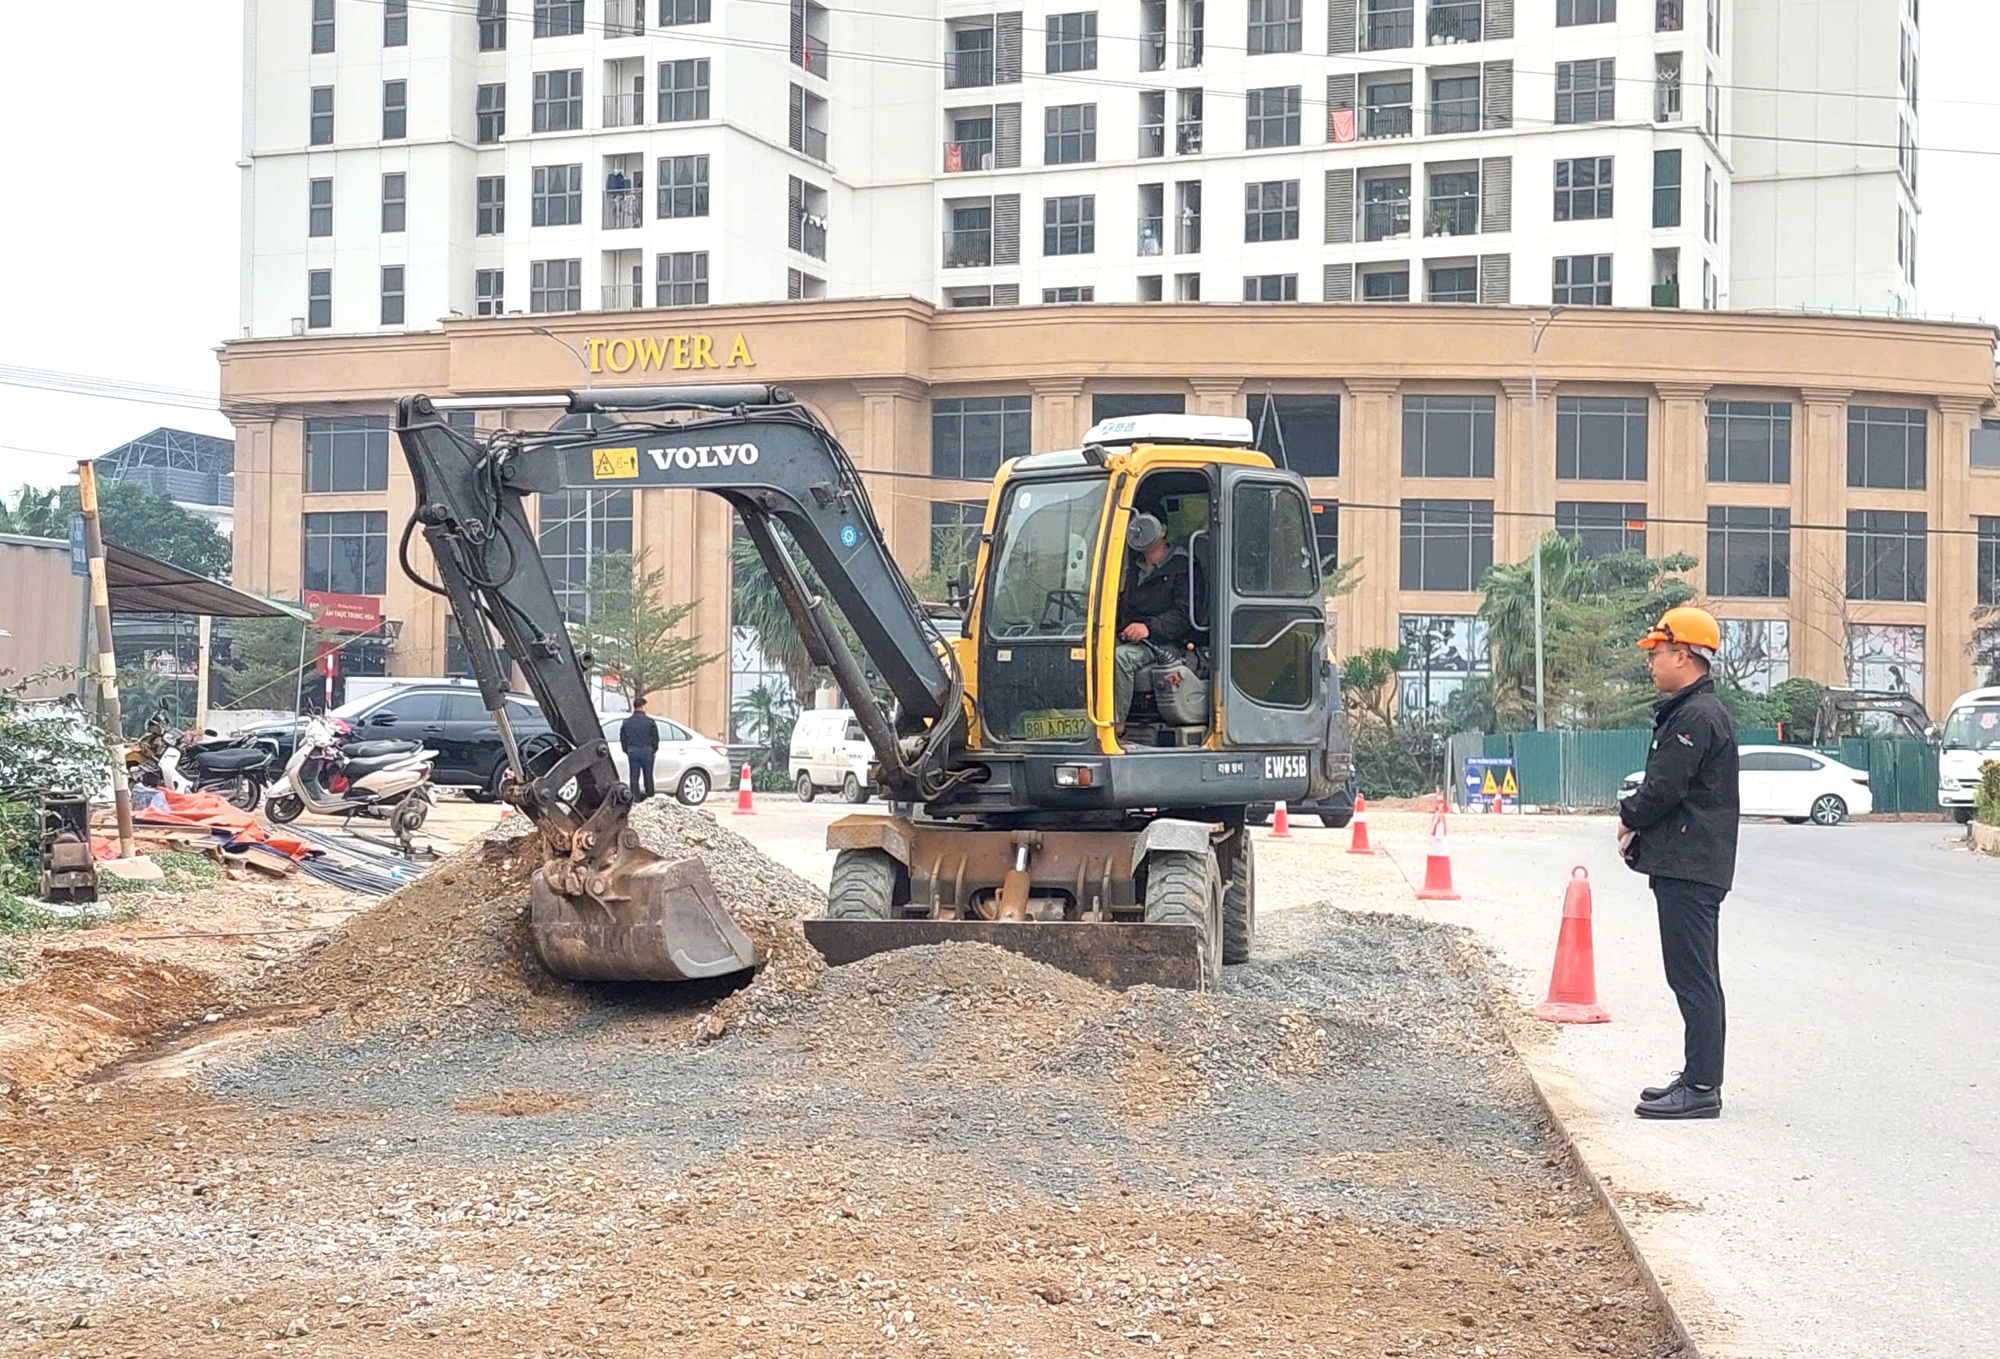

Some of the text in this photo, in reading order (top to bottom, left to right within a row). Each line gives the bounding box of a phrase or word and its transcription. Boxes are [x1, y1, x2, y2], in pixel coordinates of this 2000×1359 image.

[588, 332, 755, 373] TOWER A
[648, 443, 759, 470] VOLVO
[1265, 755, 1307, 779] EW55B
